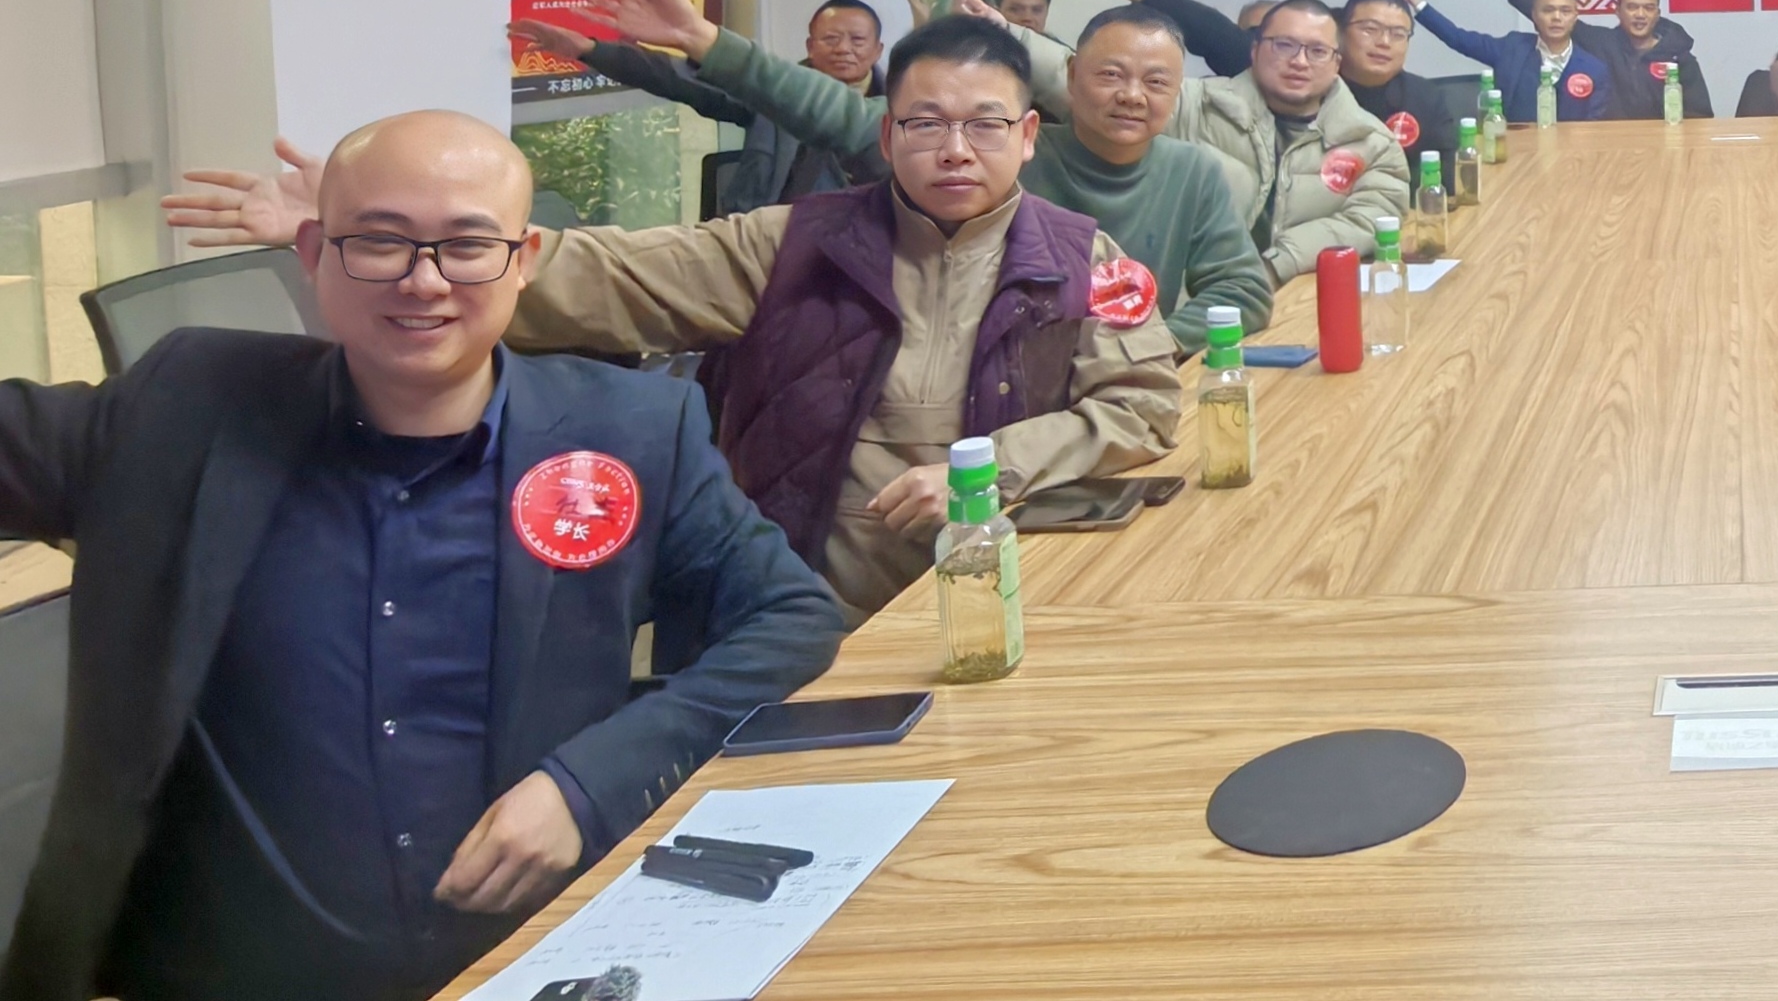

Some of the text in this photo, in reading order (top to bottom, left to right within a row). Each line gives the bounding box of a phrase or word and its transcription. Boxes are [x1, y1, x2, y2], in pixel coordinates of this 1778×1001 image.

[548, 75, 622, 94] 不忘初心 牢记
[553, 518, 590, 541] 学长
